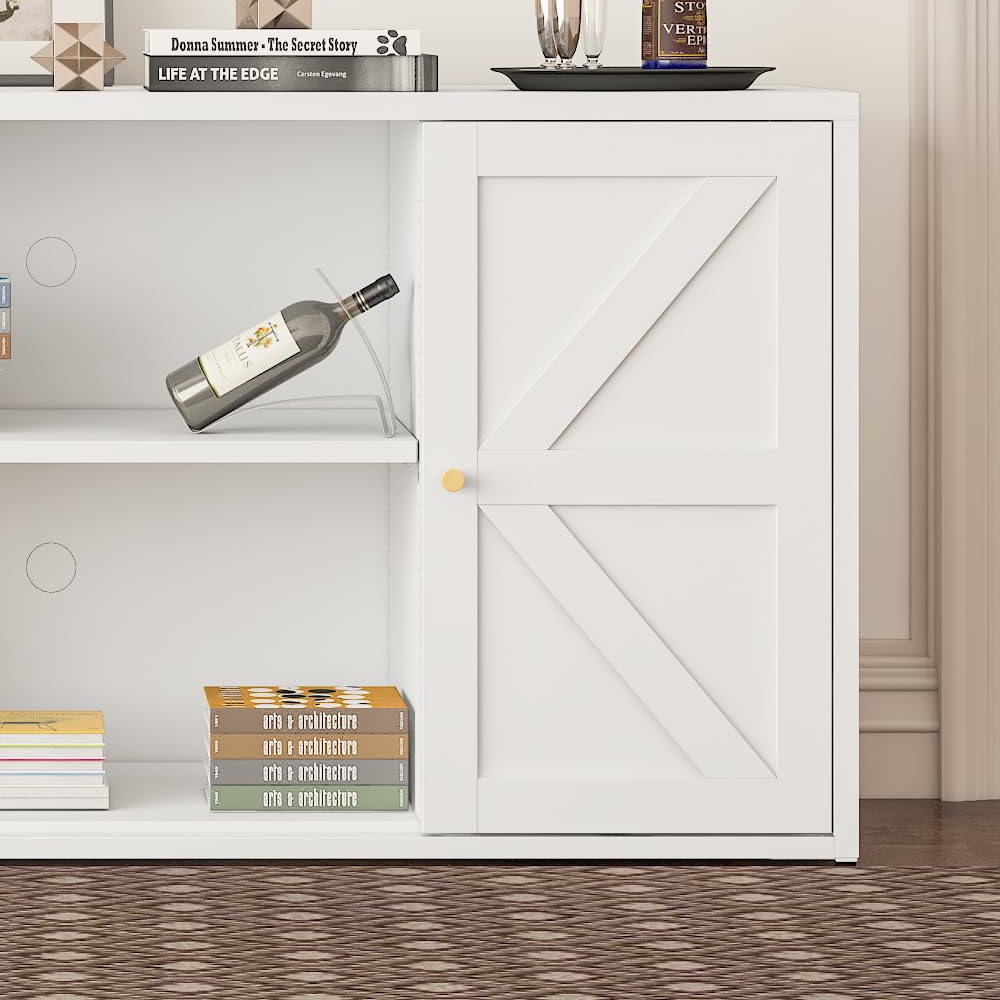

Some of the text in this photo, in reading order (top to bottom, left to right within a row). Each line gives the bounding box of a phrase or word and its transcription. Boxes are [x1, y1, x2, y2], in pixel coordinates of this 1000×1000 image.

[171, 37, 358, 56] Donna Summer The Secret Story
[158, 67, 279, 81] LIFE AT THE EDGE
[263, 712, 282, 730] arts
[298, 711, 358, 730] architecture
[263, 738, 282, 756] arts
[298, 737, 358, 756] architecture
[263, 763, 282, 781] arts
[298, 762, 358, 781] architecture
[263, 789, 282, 807] arts
[298, 788, 358, 807] architecture
